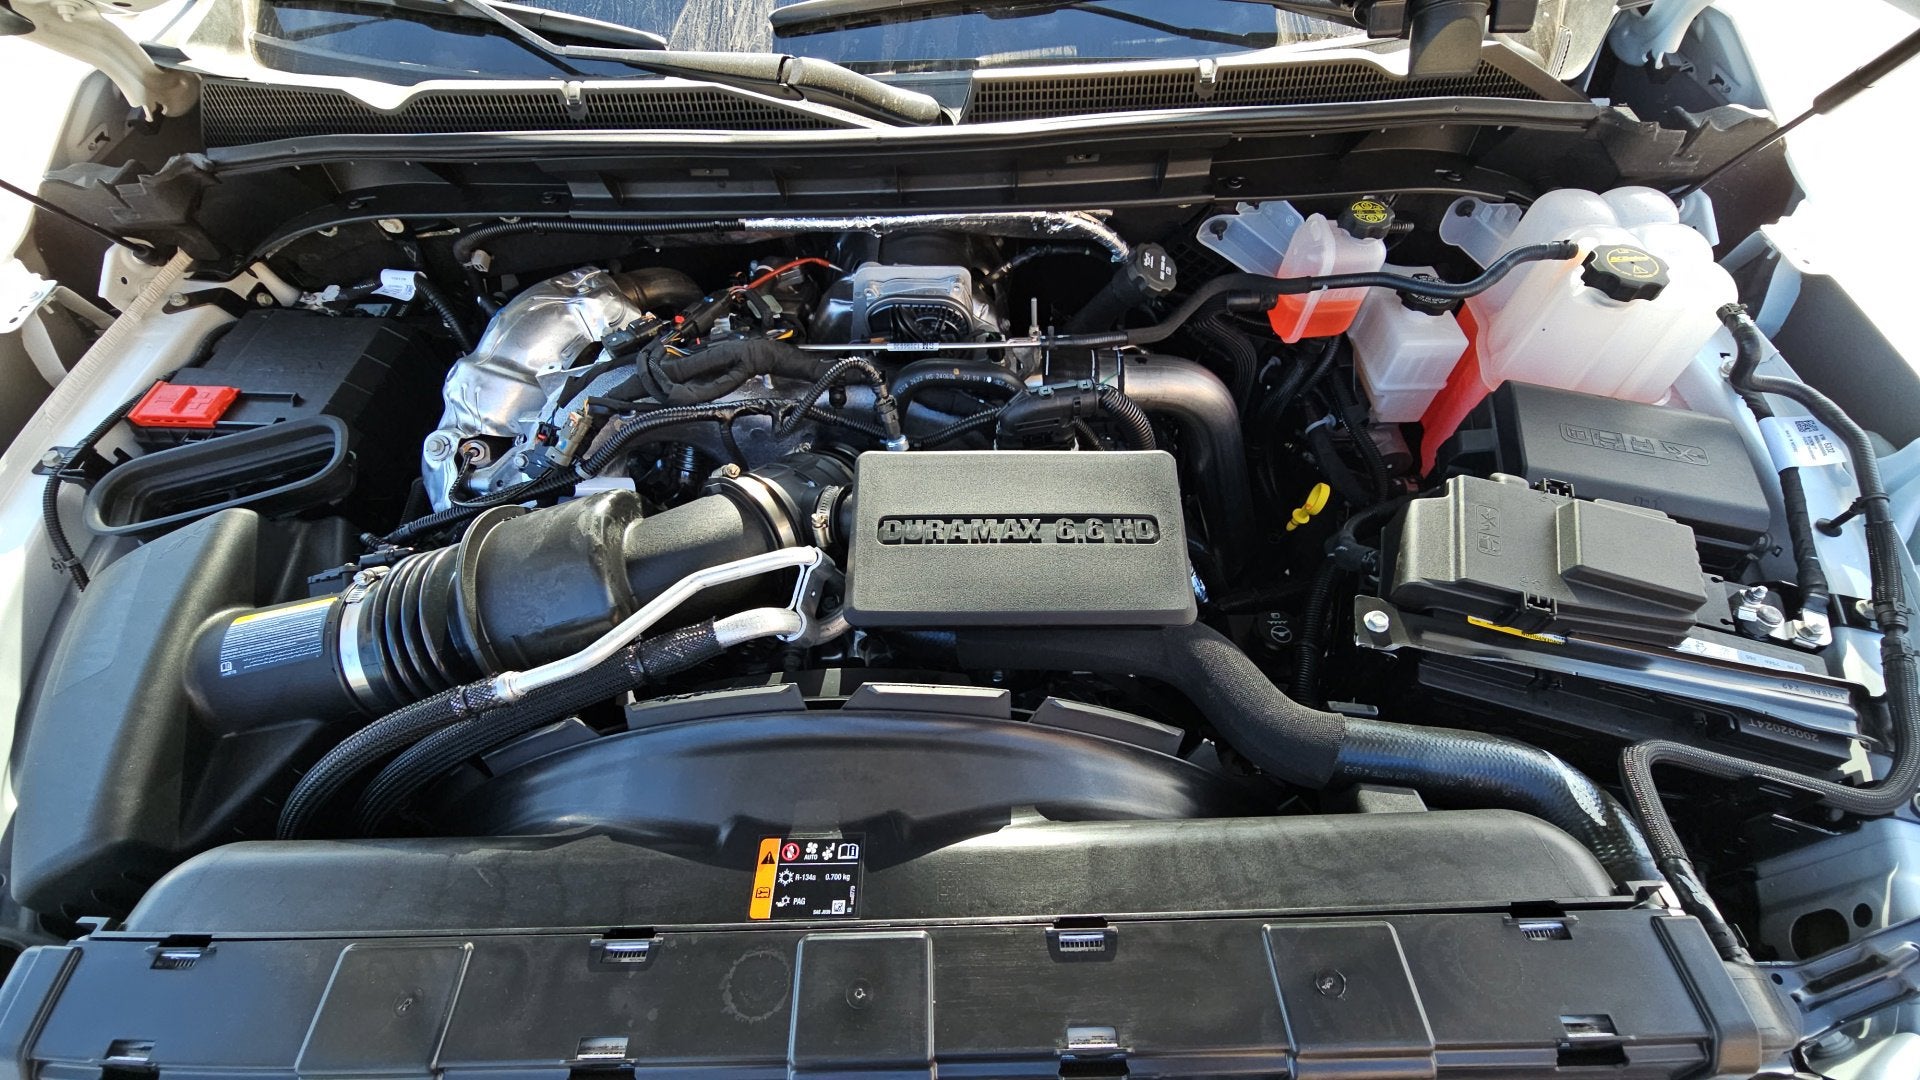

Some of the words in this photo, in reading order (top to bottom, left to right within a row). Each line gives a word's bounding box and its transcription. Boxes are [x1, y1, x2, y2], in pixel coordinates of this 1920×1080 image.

[880, 518, 1042, 544] DURAMAX
[1055, 518, 1105, 544] 6.6
[1112, 518, 1159, 544] HD
[842, 873, 851, 882] kg
[793, 897, 806, 905] PAG
